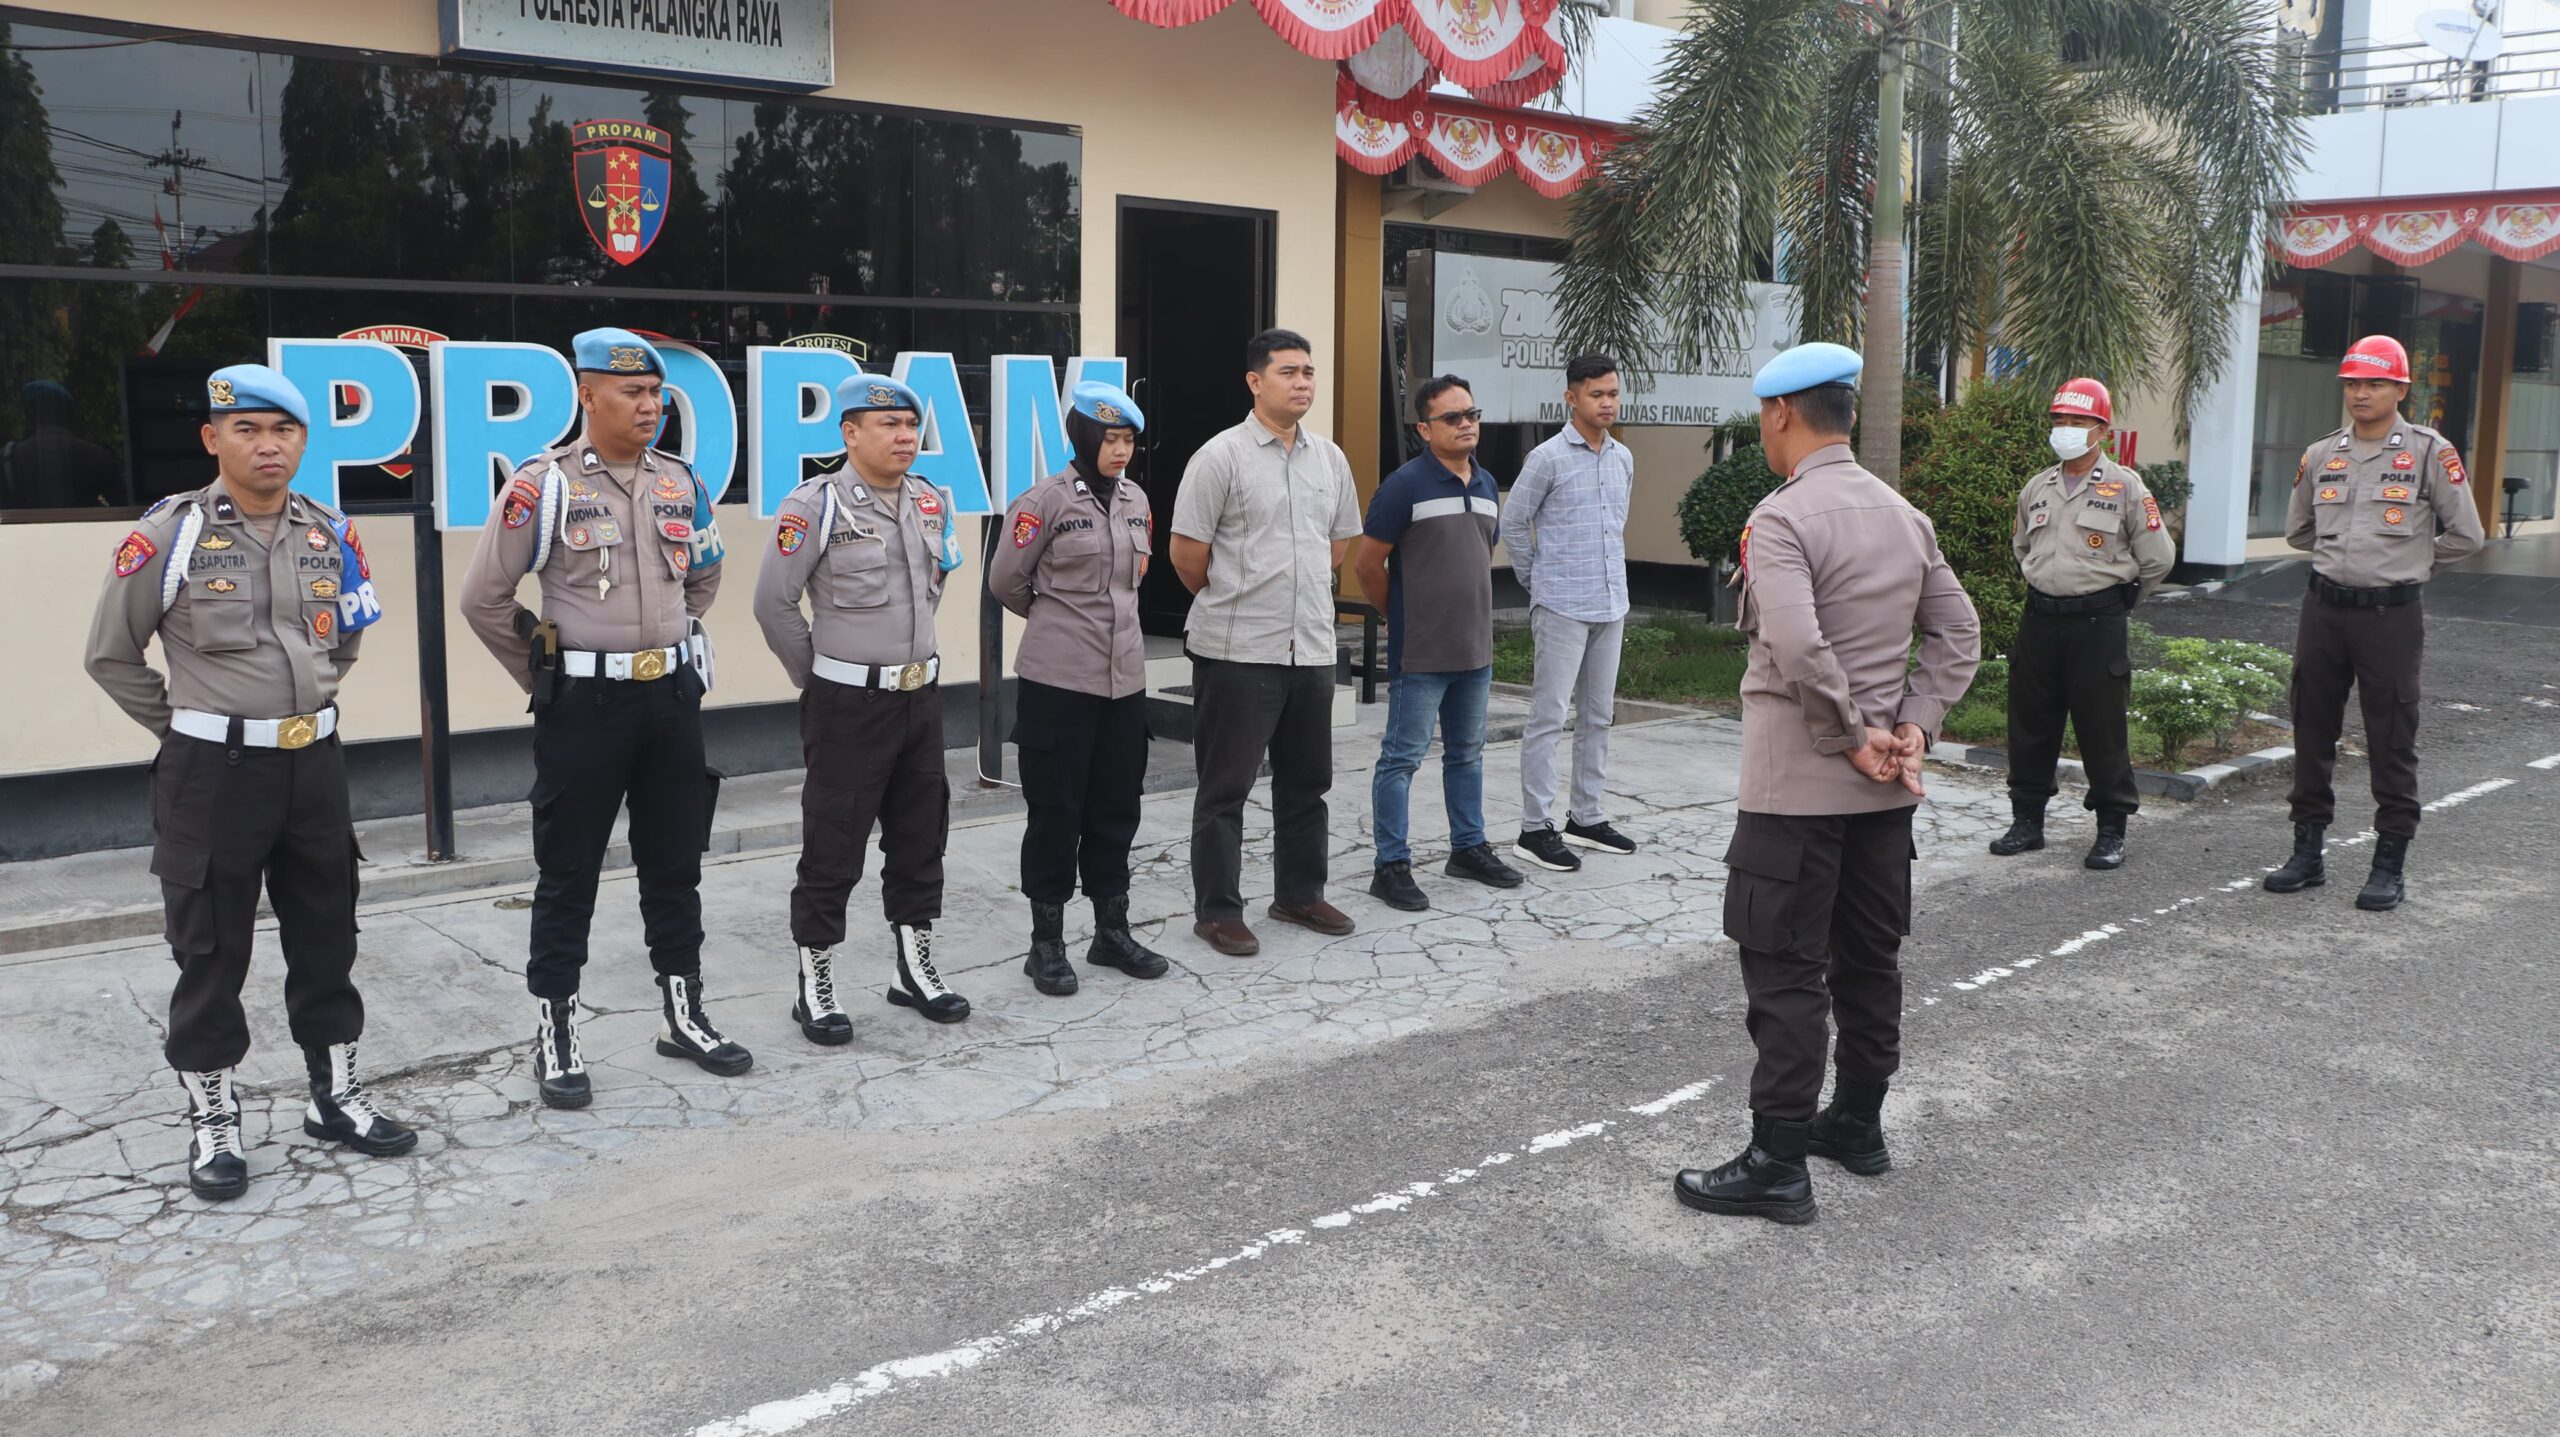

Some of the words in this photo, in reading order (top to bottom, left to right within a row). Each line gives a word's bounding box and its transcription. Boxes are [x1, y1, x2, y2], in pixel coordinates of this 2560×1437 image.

[630, 0, 731, 41] PALANGKA
[736, 0, 783, 47] RAYA
[587, 123, 657, 143] PROPAM
[796, 336, 852, 353] PROFESI
[1618, 403, 1658, 422] UNAS
[1661, 405, 1720, 424] FINANCE
[2380, 473, 2416, 483] POLRI
[653, 503, 693, 519] POLRI
[2087, 500, 2118, 512] POLRI
[1054, 518, 1094, 534] YUYUN
[189, 554, 247, 571] D.SAPUTRA
[299, 556, 341, 570] POLRI
